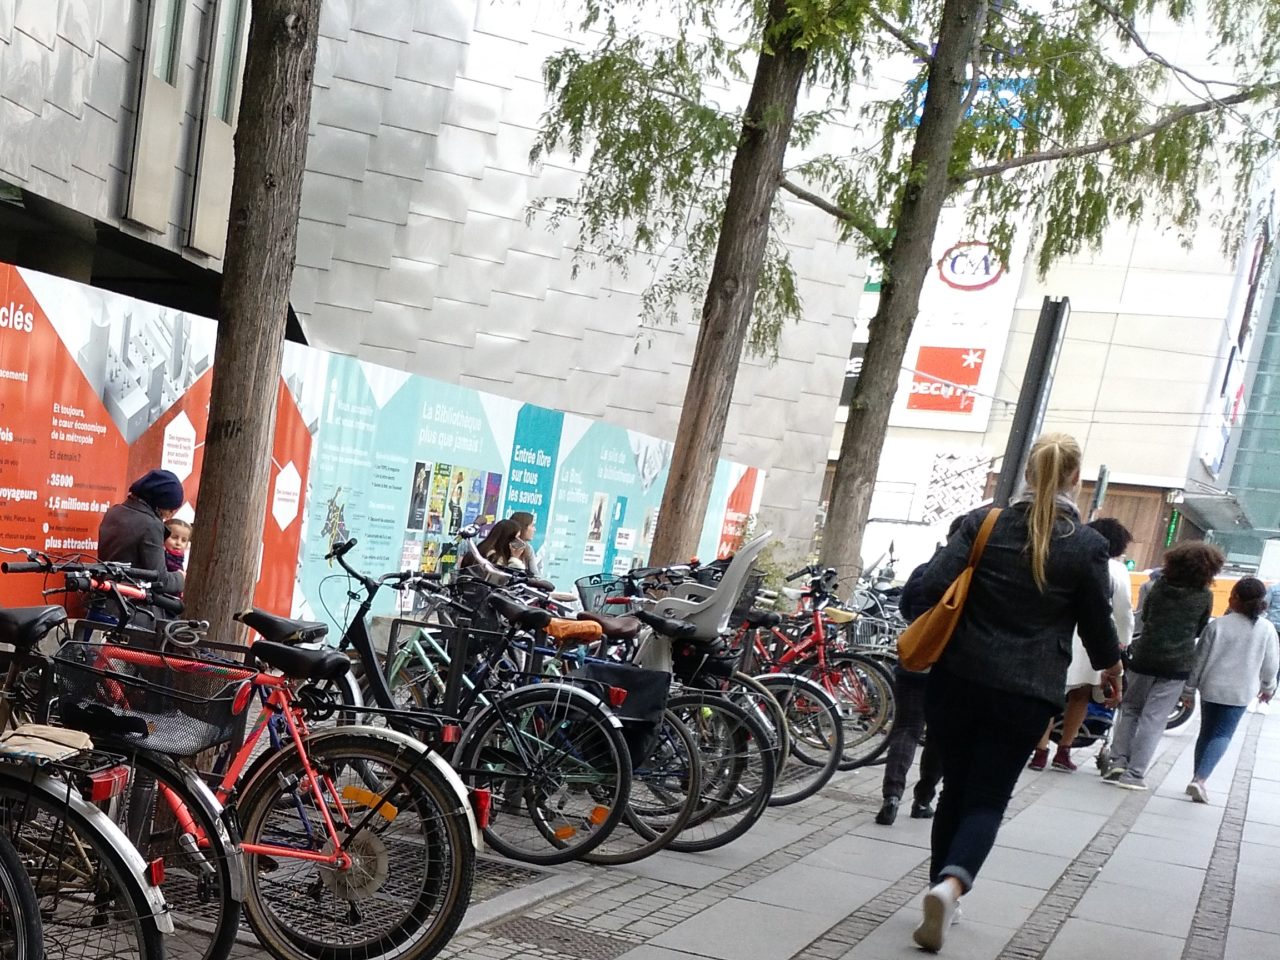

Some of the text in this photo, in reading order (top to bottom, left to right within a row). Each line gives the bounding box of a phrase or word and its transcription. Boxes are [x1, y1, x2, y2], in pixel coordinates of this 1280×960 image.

[0, 302, 33, 332] clés
[53, 403, 60, 413] Et
[422, 401, 482, 431] La Bibliothèque
[420, 428, 437, 444] plus
[438, 432, 454, 448] que
[453, 435, 480, 453] jamais
[514, 445, 551, 467] Entrée libre
[511, 470, 538, 485] sur tous
[61, 497, 89, 511] millions
[90, 500, 100, 511] de
[508, 486, 542, 505] les savoirs
[45, 536, 62, 550] plus
